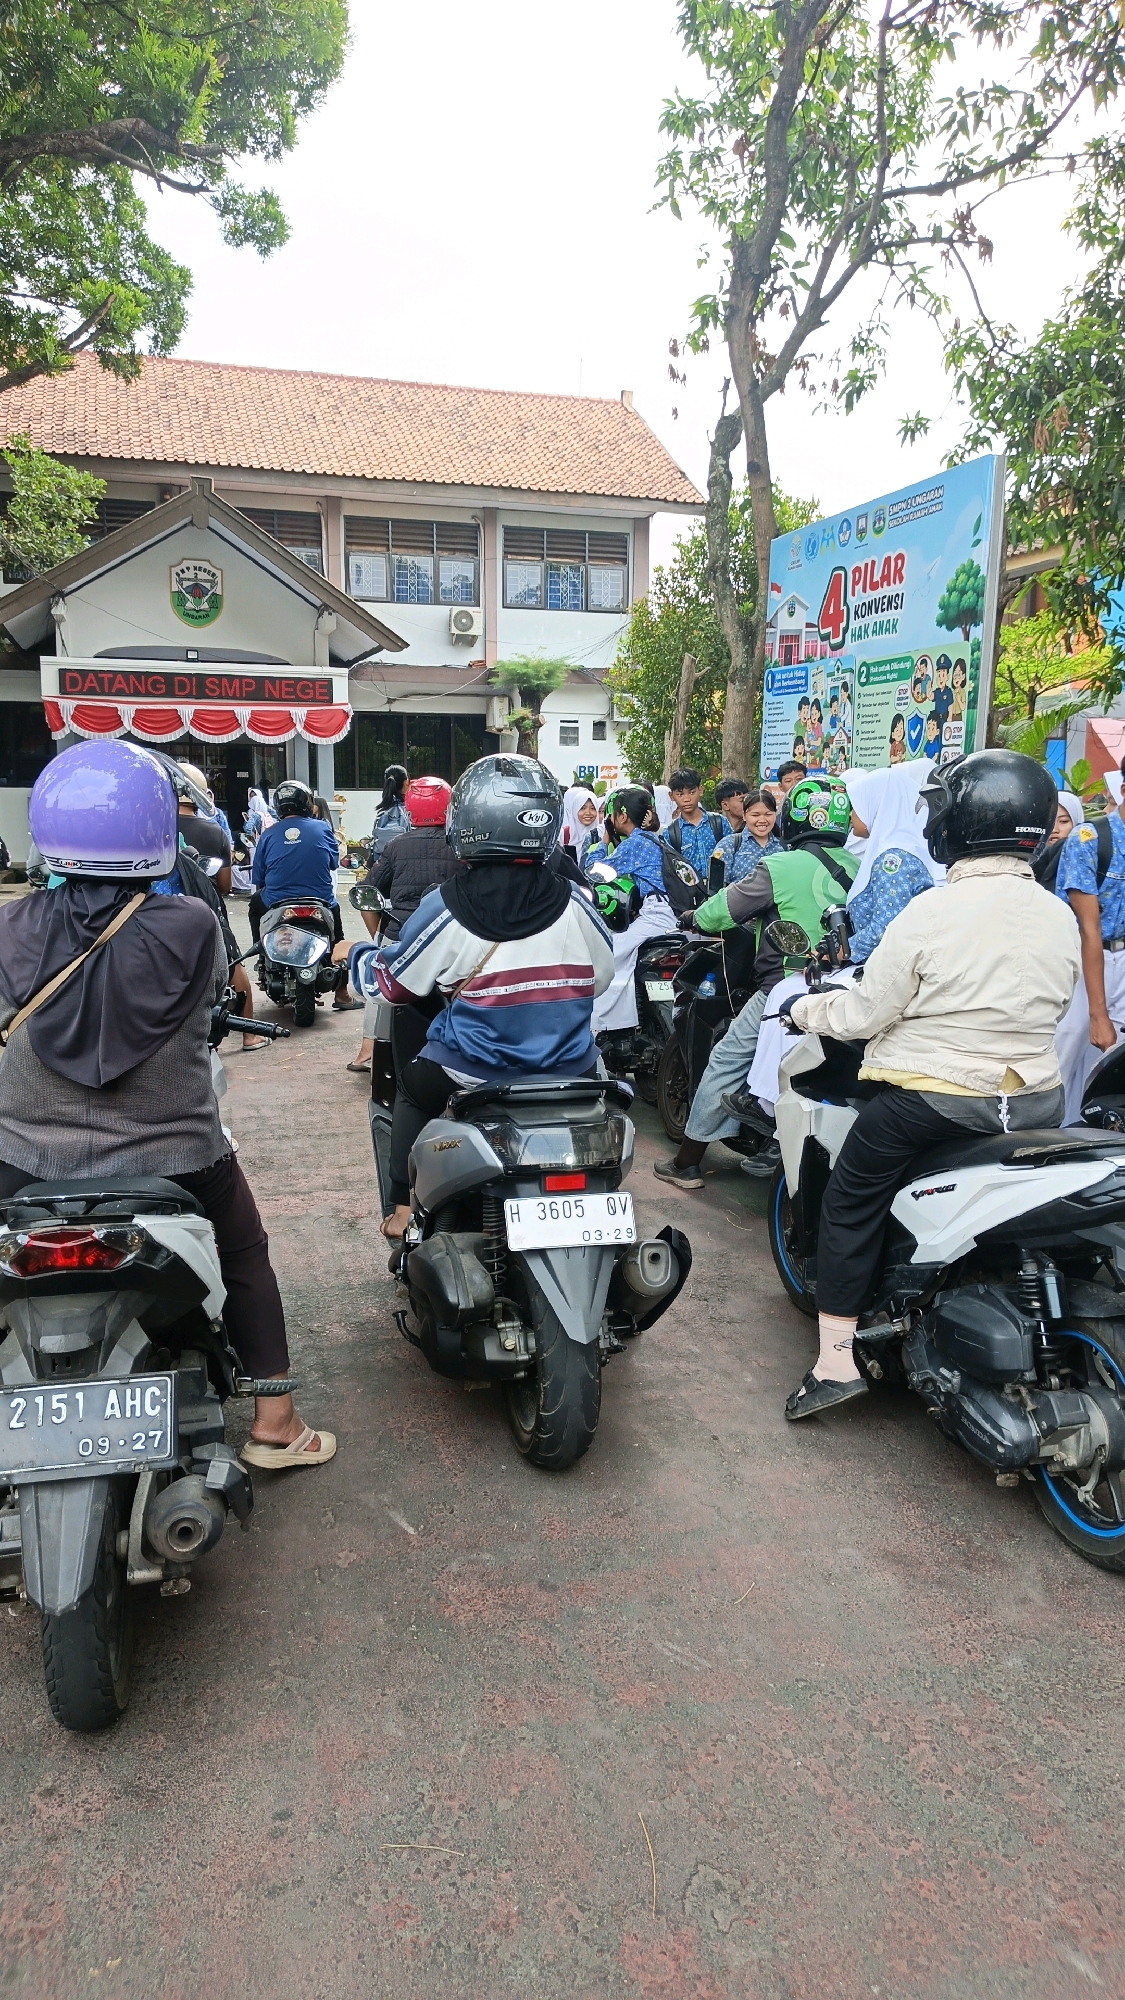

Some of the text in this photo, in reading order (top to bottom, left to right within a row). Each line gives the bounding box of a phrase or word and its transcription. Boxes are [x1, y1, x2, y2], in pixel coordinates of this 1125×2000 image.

[911, 484, 945, 507] UNGARAN
[175, 565, 219, 580] SMP NEGERI
[850, 552, 906, 598] PILAR
[182, 610, 211, 621] UNGARAN
[819, 569, 847, 645] 4
[853, 592, 905, 622] KONVENSI
[850, 617, 899, 643] HAK ANAK
[65, 672, 330, 700] DATANG DI SMP NEGE
[768, 673, 772, 690] 1
[860, 666, 867, 683] 2
[460, 827, 474, 837] DJ
[1015, 826, 1046, 835] HONDA
[509, 1203, 521, 1223] H
[536, 1199, 585, 1220] 3605
[9, 1386, 161, 1430] 2151 AHC
